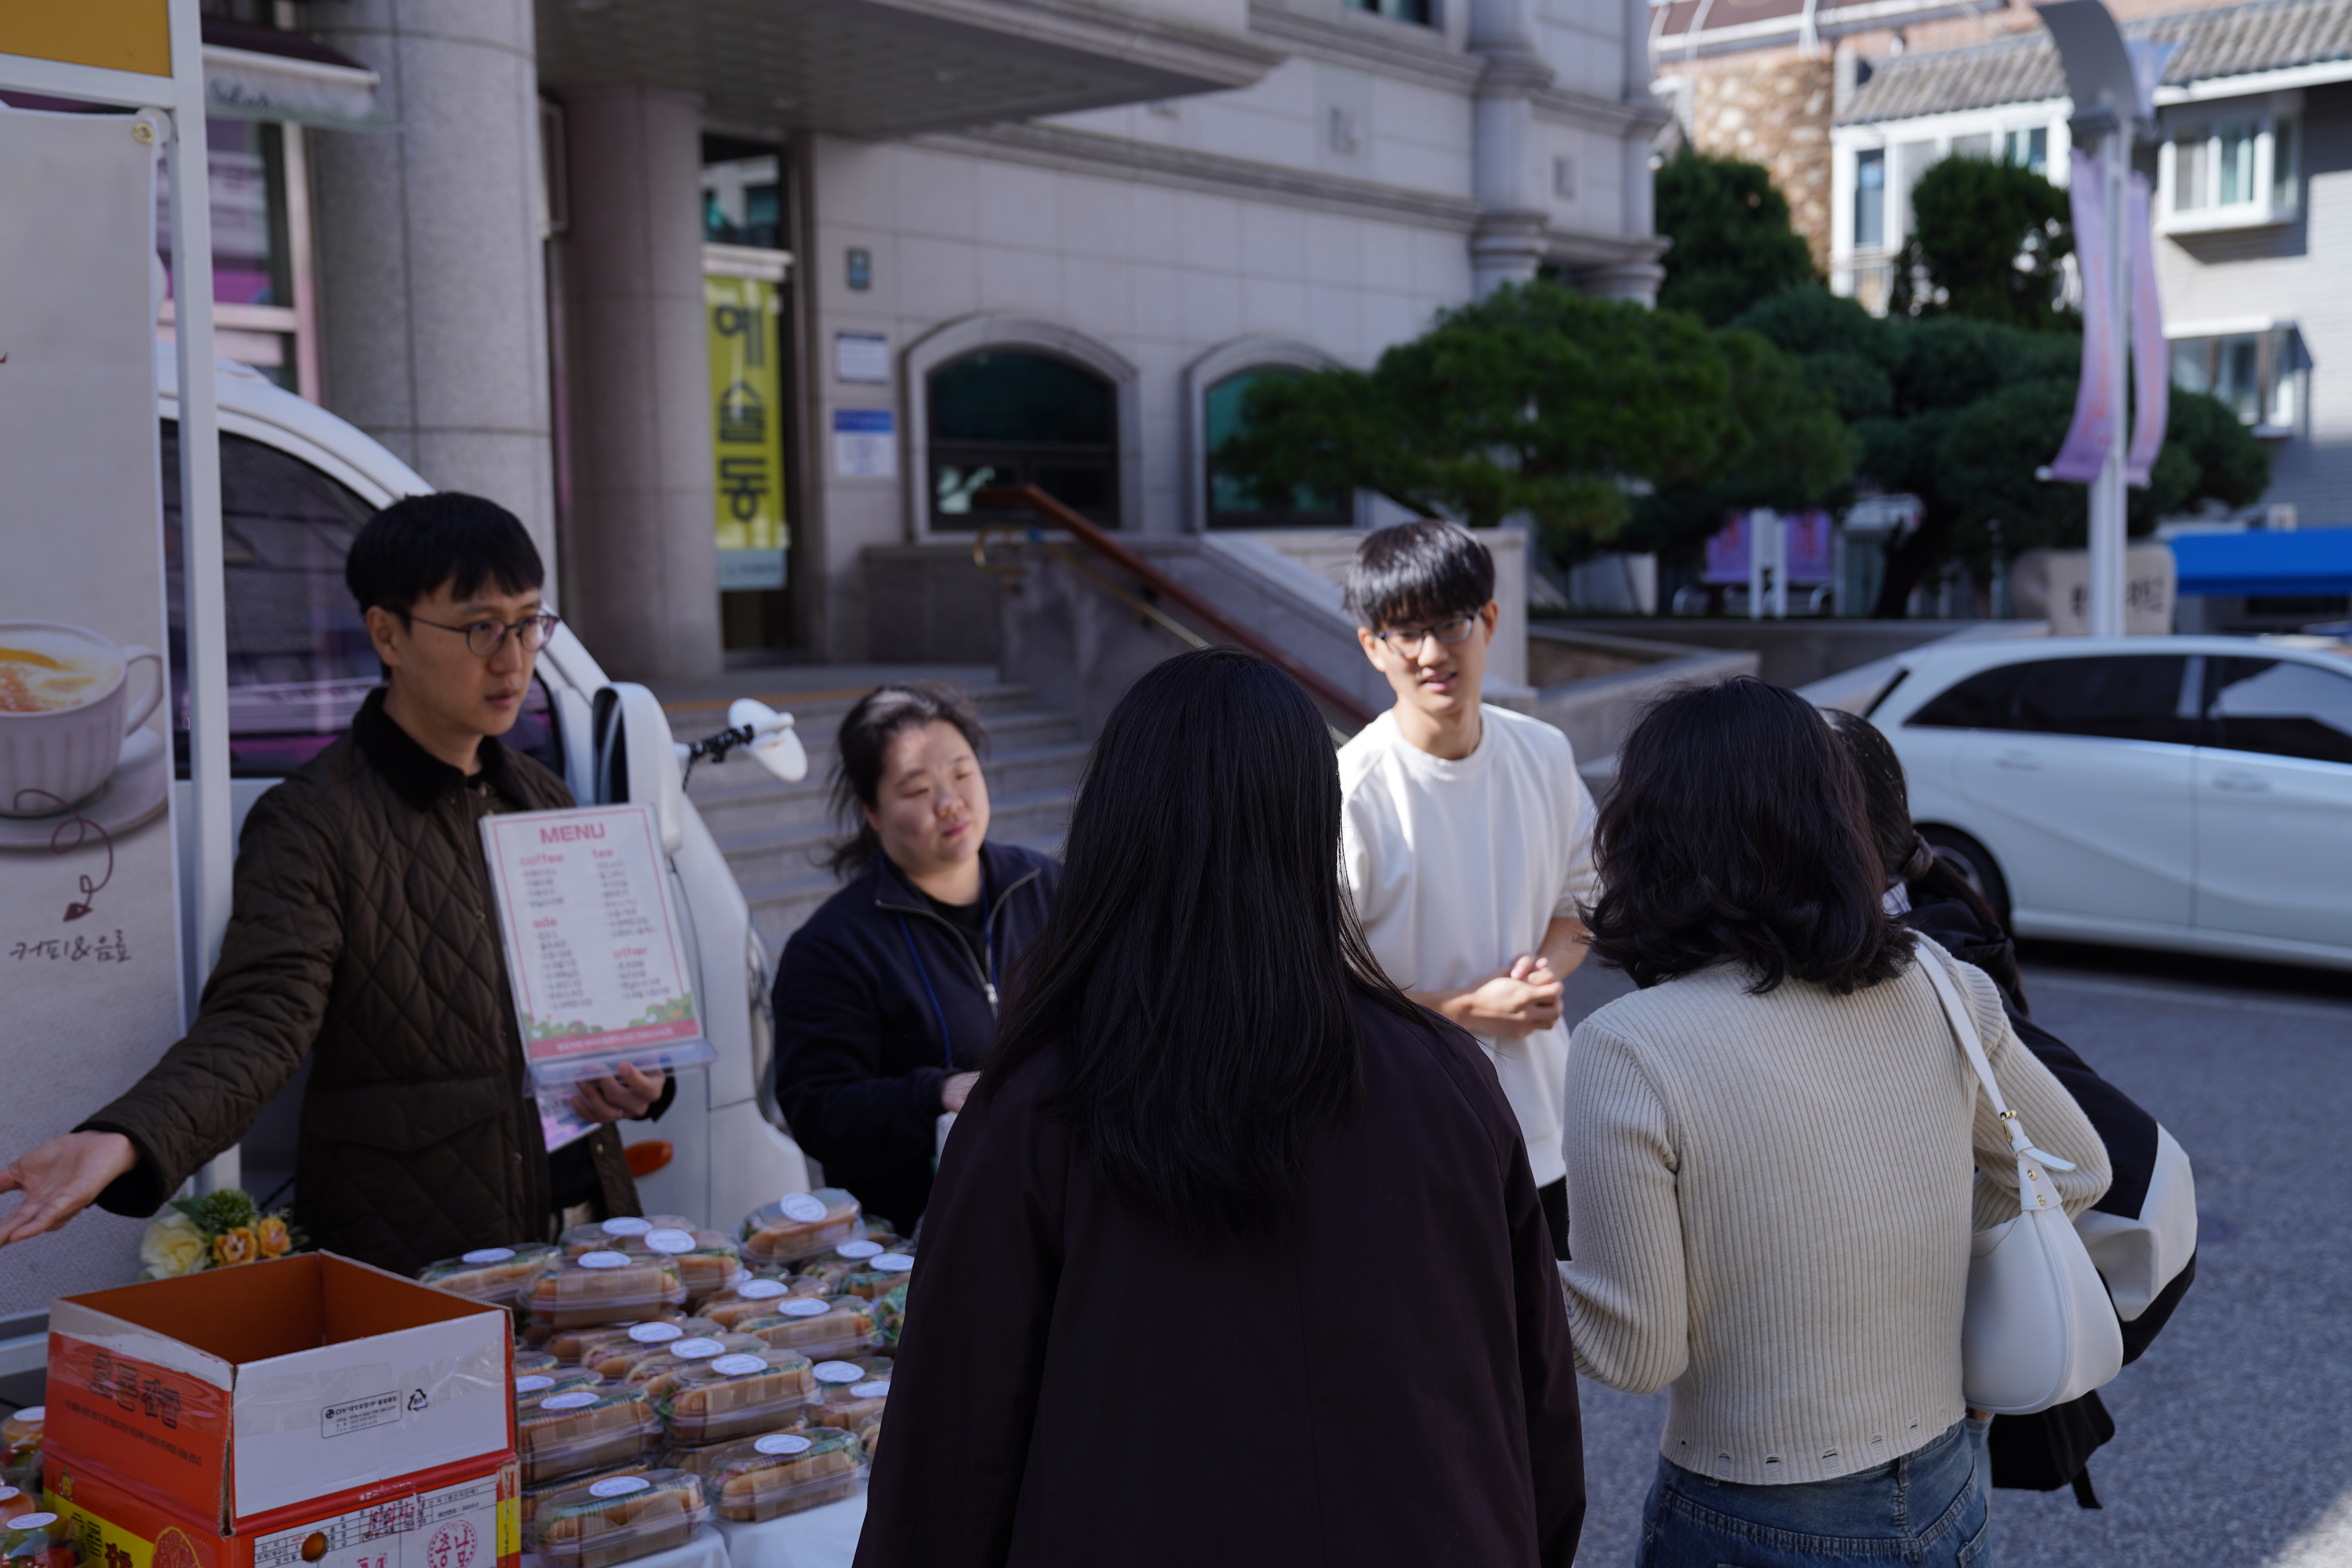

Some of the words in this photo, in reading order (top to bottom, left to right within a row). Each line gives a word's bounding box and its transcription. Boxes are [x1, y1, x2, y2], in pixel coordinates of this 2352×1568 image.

[539, 823, 606, 844] MENU
[520, 852, 564, 867] coffee
[592, 848, 614, 859] tea
[613, 946, 648, 959] other
